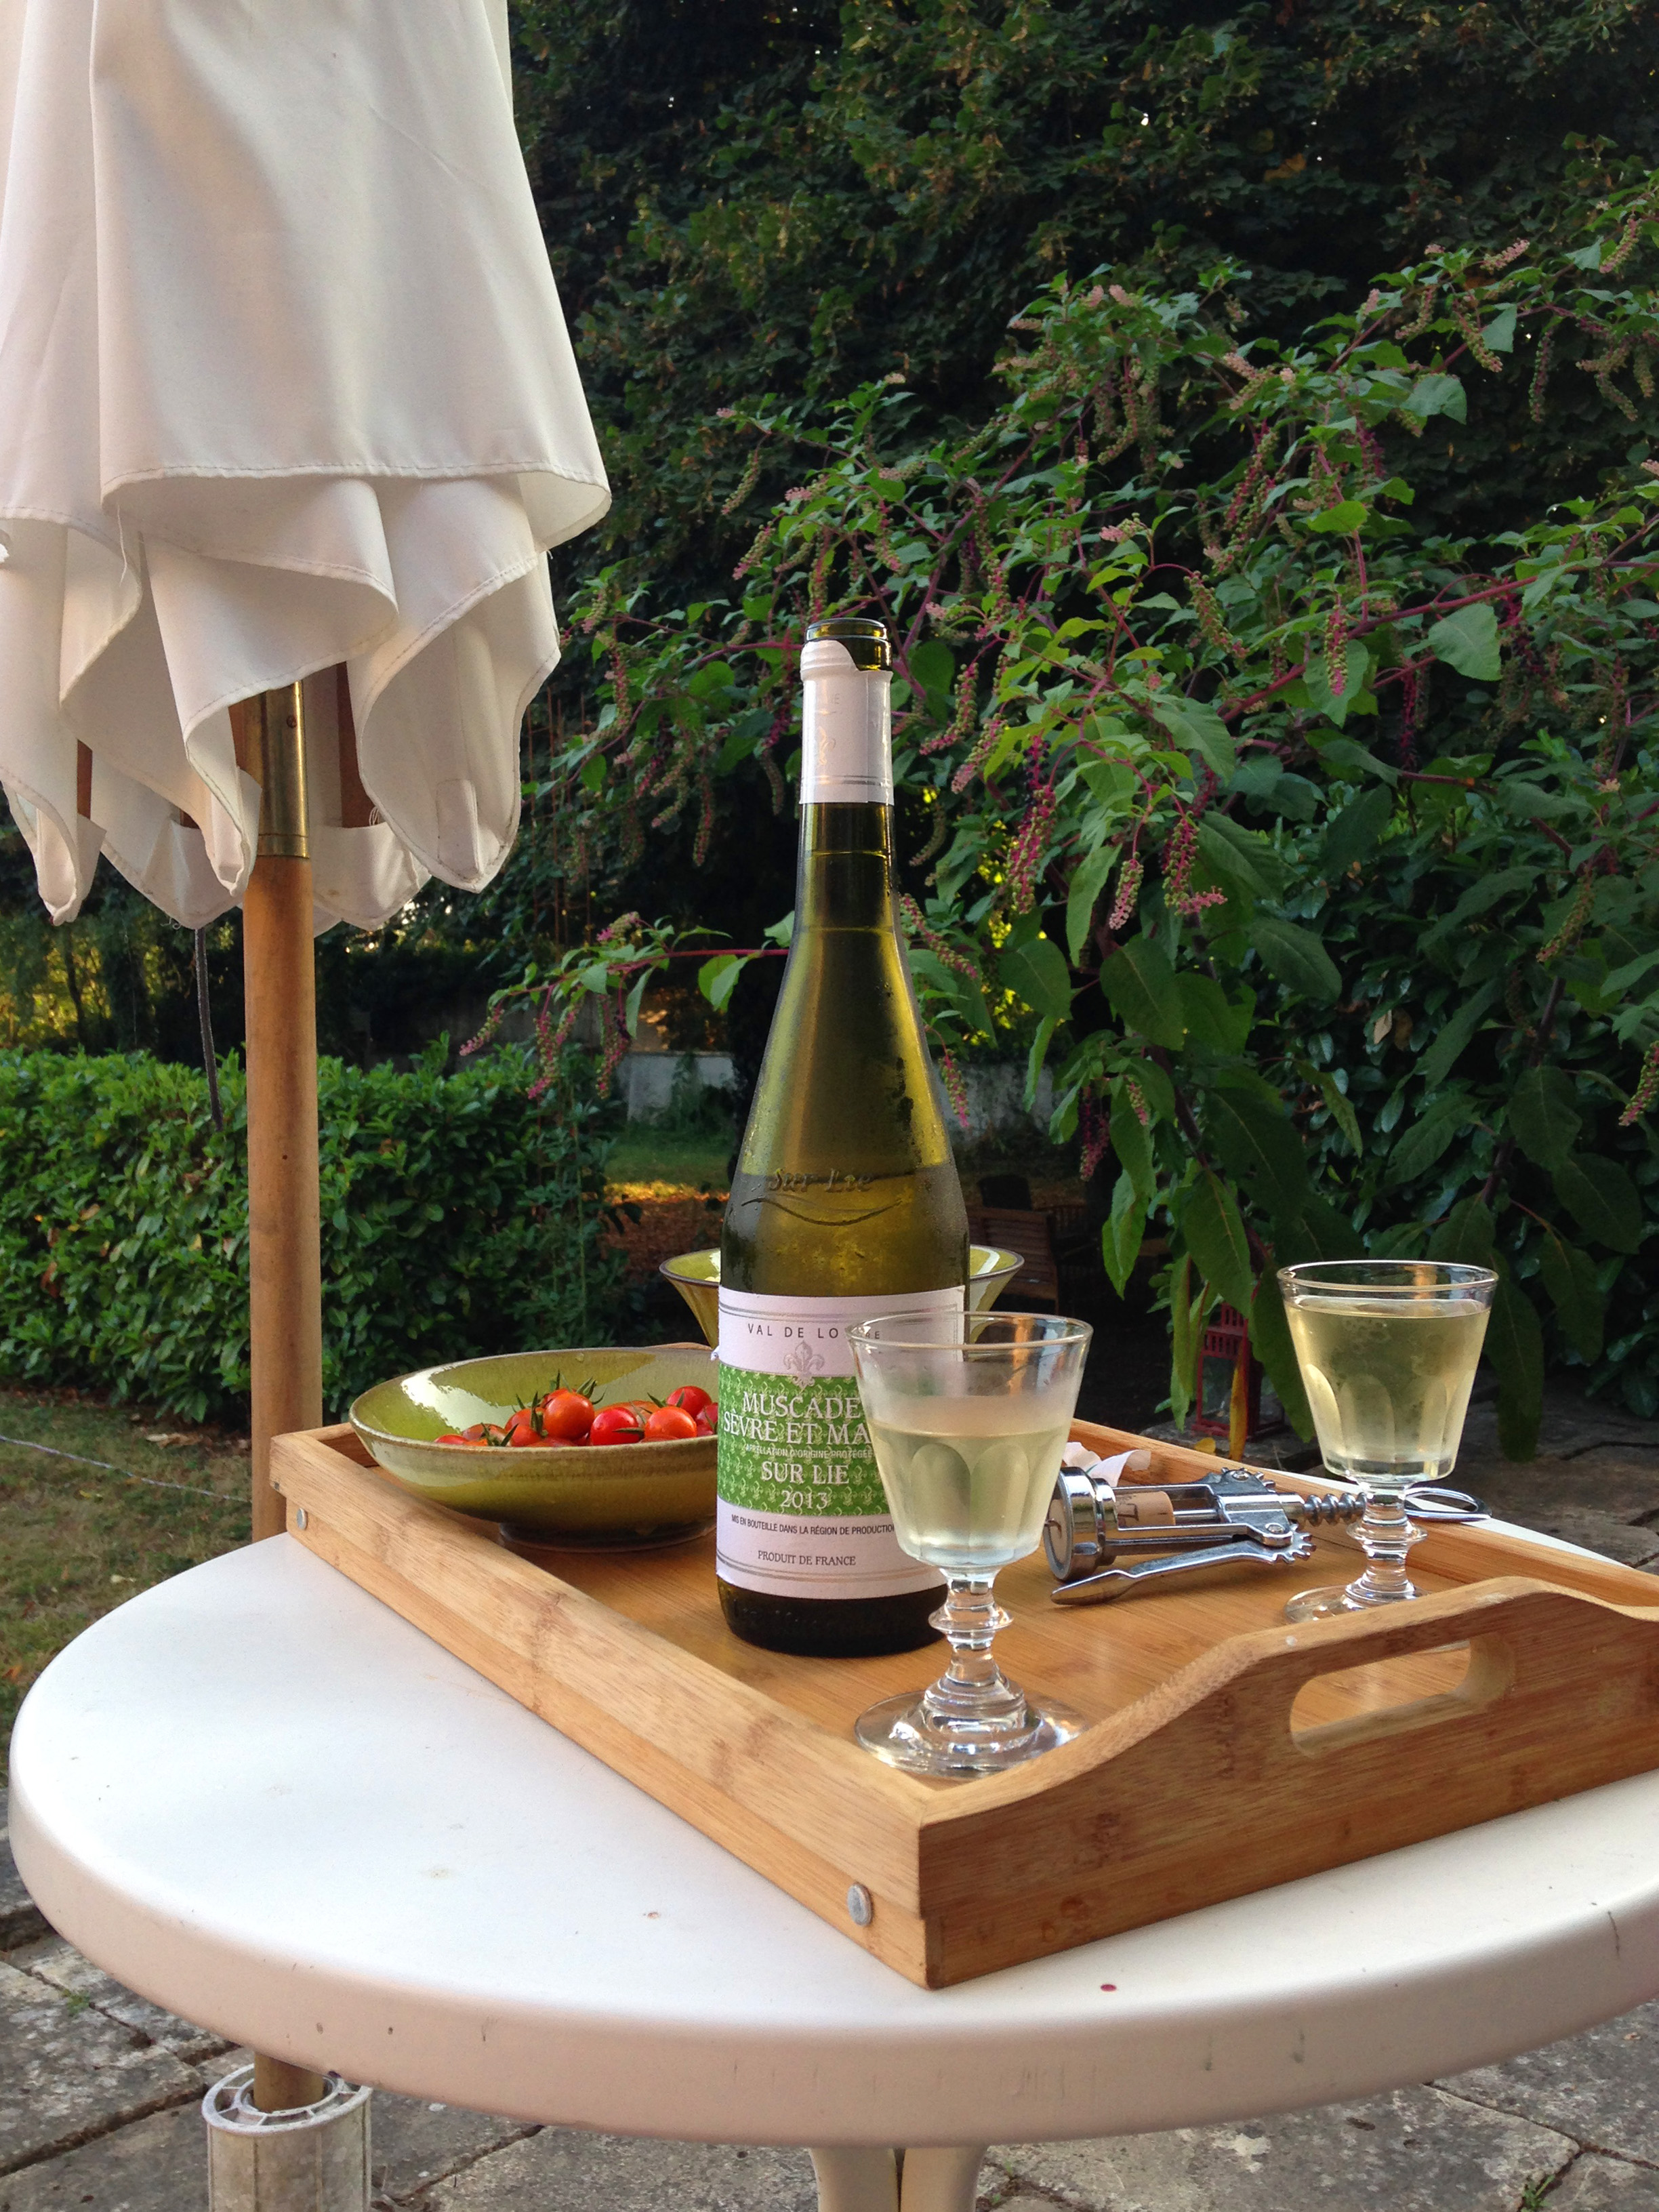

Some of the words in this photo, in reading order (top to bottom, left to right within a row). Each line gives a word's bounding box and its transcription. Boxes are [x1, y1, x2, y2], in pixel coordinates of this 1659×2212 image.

[747, 1323, 773, 1336] VAL
[784, 1326, 804, 1338] DE
[817, 1328, 880, 1339] LORE
[786, 1422, 818, 1445] ET
[745, 1443, 787, 1456] APPELLATION
[790, 1448, 829, 1458] D'ORIGINE
[761, 1461, 805, 1484] SUR
[813, 1465, 850, 1485] LIE
[780, 1490, 828, 1509] 2013
[731, 1514, 739, 1524] MIS
[740, 1517, 747, 1526] EN
[747, 1519, 778, 1532] BOUTEILLE
[779, 1524, 798, 1534] DANS
[799, 1526, 809, 1535] LA
[811, 1525, 838, 1536] RÉGION
[840, 1527, 851, 1536] DE
[758, 1550, 796, 1563] PRODUIT
[799, 1555, 813, 1565] DE
[815, 1556, 857, 1566] FRANCE
